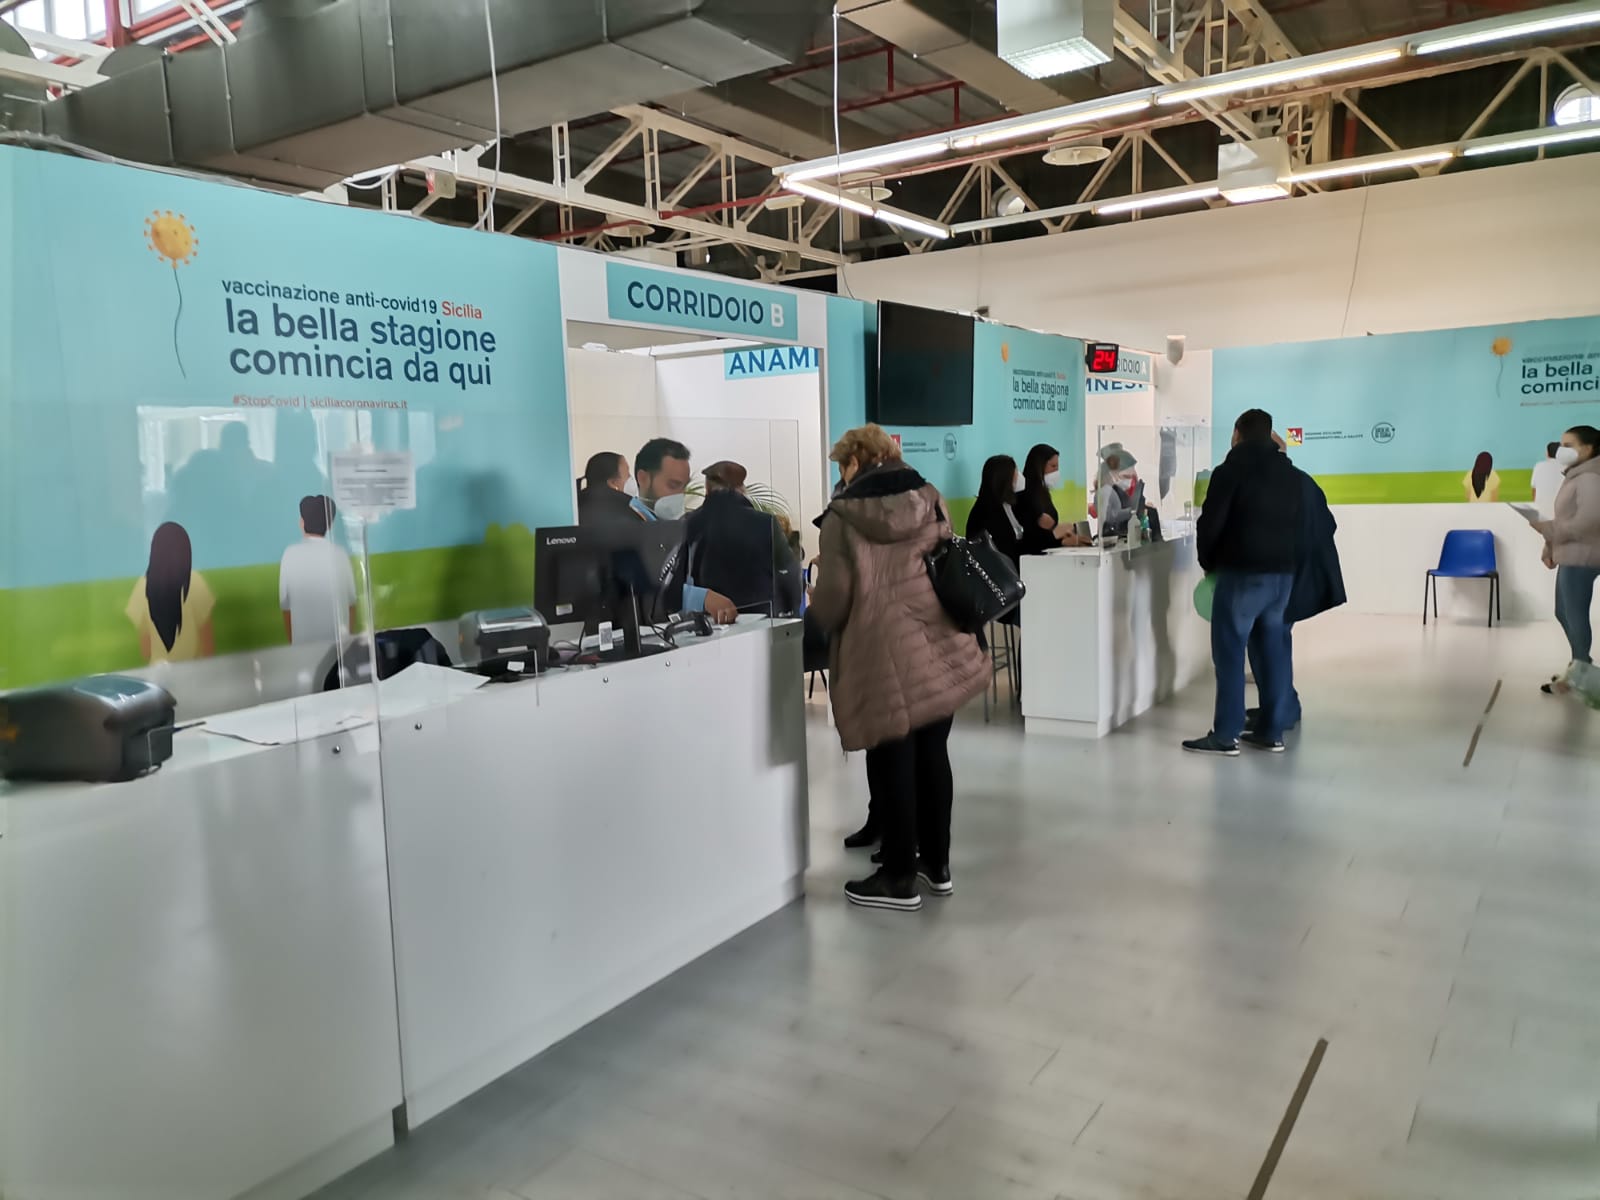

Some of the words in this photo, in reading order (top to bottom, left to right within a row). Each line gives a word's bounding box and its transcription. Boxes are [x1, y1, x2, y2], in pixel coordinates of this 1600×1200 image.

[222, 279, 339, 304] vaccinazione
[345, 292, 437, 314] anti-covid19
[441, 301, 482, 319] Sicilia
[627, 281, 764, 325] CORRIDOIO
[770, 303, 785, 328] B
[225, 298, 259, 336] la
[273, 302, 359, 342] bella
[371, 315, 496, 355] stagione
[230, 345, 393, 381] comincia
[403, 351, 439, 383] da
[450, 357, 492, 391] qui
[1093, 350, 1116, 370] 24
[1522, 365, 1538, 379] la
[1545, 361, 1593, 377] bella
[1012, 376, 1020, 392] la
[1022, 377, 1039, 393] bella
[1041, 380, 1069, 398] stagione
[1012, 396, 1046, 410] comincia
[1047, 397, 1056, 411] da
[1057, 398, 1068, 414] qui
[546, 537, 577, 545] Lenovo
